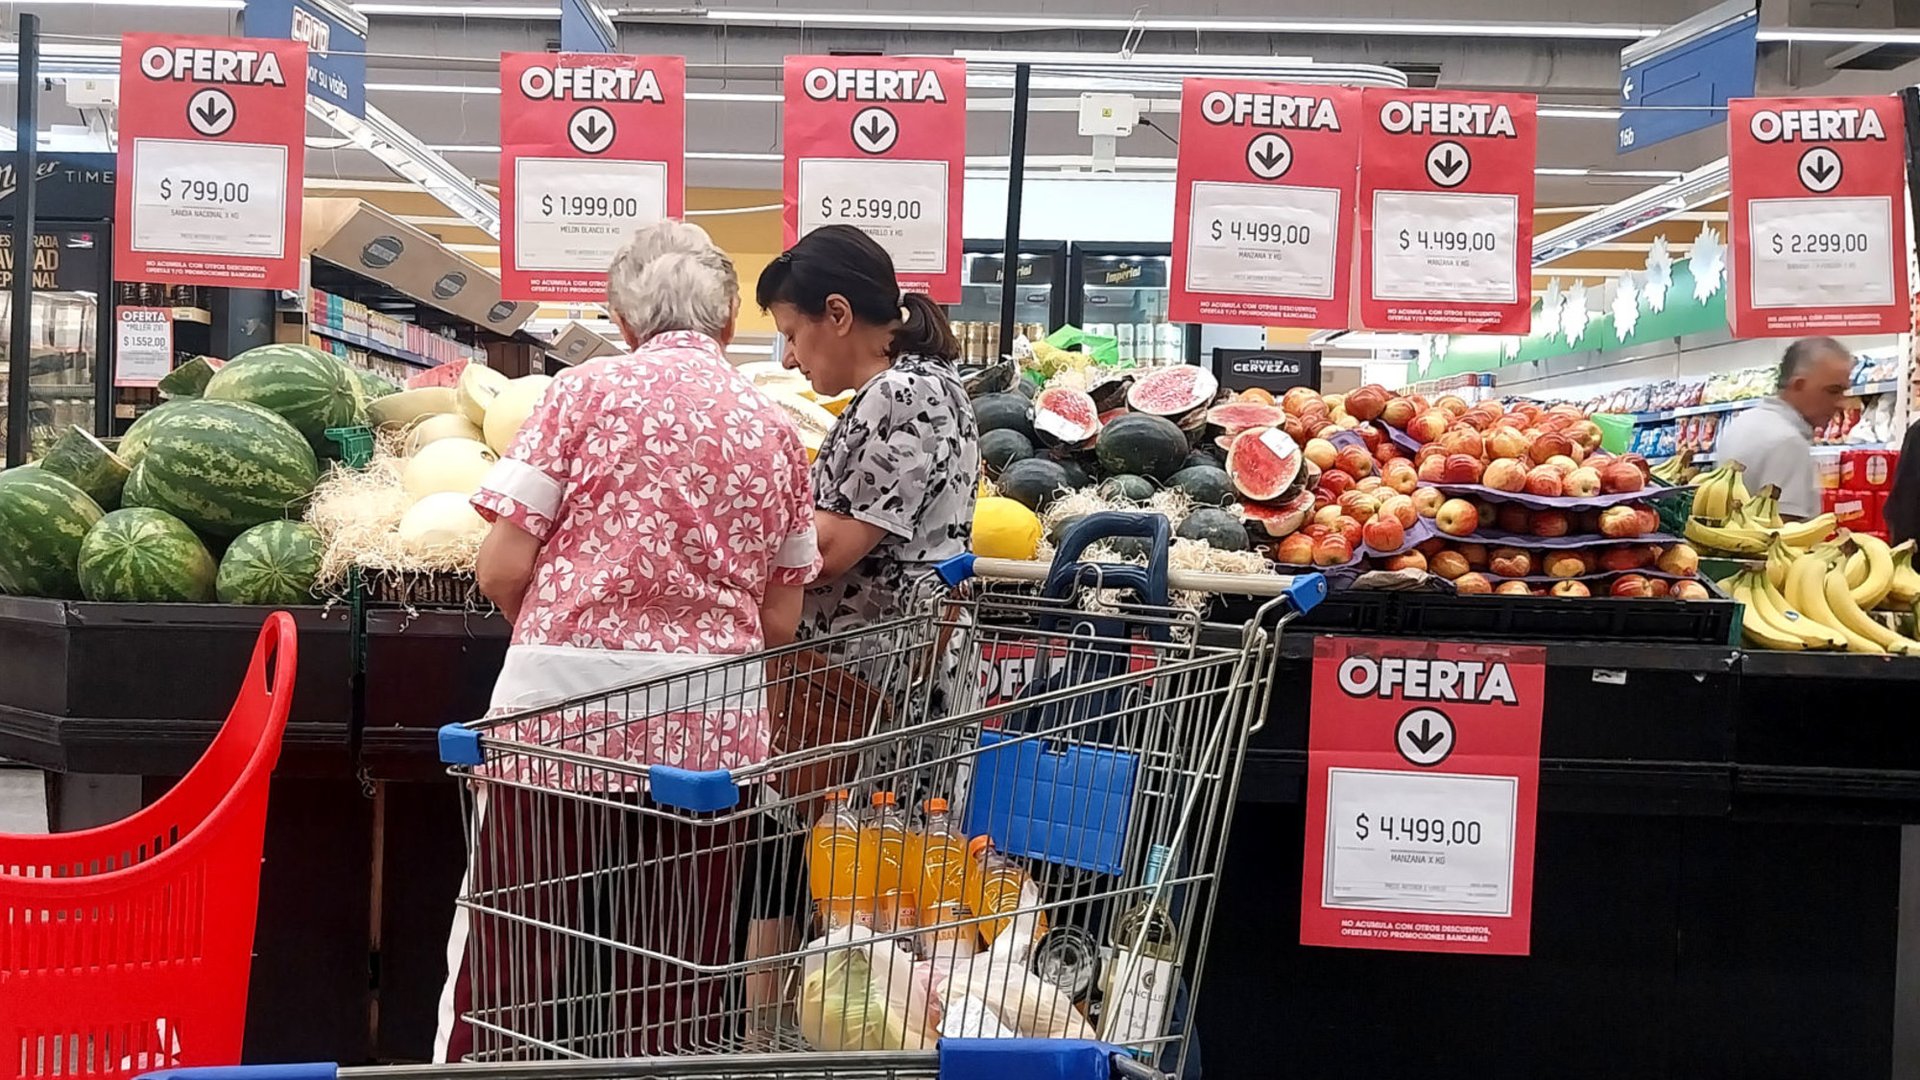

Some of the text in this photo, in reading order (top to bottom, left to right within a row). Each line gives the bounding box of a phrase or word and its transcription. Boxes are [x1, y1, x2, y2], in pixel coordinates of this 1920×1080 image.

[141, 46, 285, 86] OFERTA
[319, 70, 328, 89] su
[329, 72, 348, 100] visita
[520, 66, 664, 103] OFERTA
[803, 68, 947, 103] OFERTA
[1201, 91, 1341, 131] OFERTA
[1379, 100, 1518, 137] OFERTA
[1619, 128, 1635, 148] 16b
[1750, 108, 1887, 143] OFERTA
[65, 170, 114, 184] TIME
[160, 177, 249, 204] $ 799,00
[542, 194, 637, 218] $ 1.999,00
[822, 196, 921, 221] $ 2.599,00
[1211, 219, 1310, 245] $ 4.499,00
[1400, 229, 1496, 253] $ 4.499,00
[1772, 233, 1868, 254] $ 2.299,00
[1105, 265, 1142, 284] Imperial
[122, 311, 166, 322] OFERTA
[123, 336, 130, 347] $
[1233, 363, 1299, 373] CERVEZAS
[1337, 655, 1519, 706] OFERTA
[1356, 813, 1481, 846] $ 4.499,00
[1391, 854, 1426, 864] MANZANA
[1435, 856, 1446, 865] KG
[1394, 922, 1414, 931] CON
